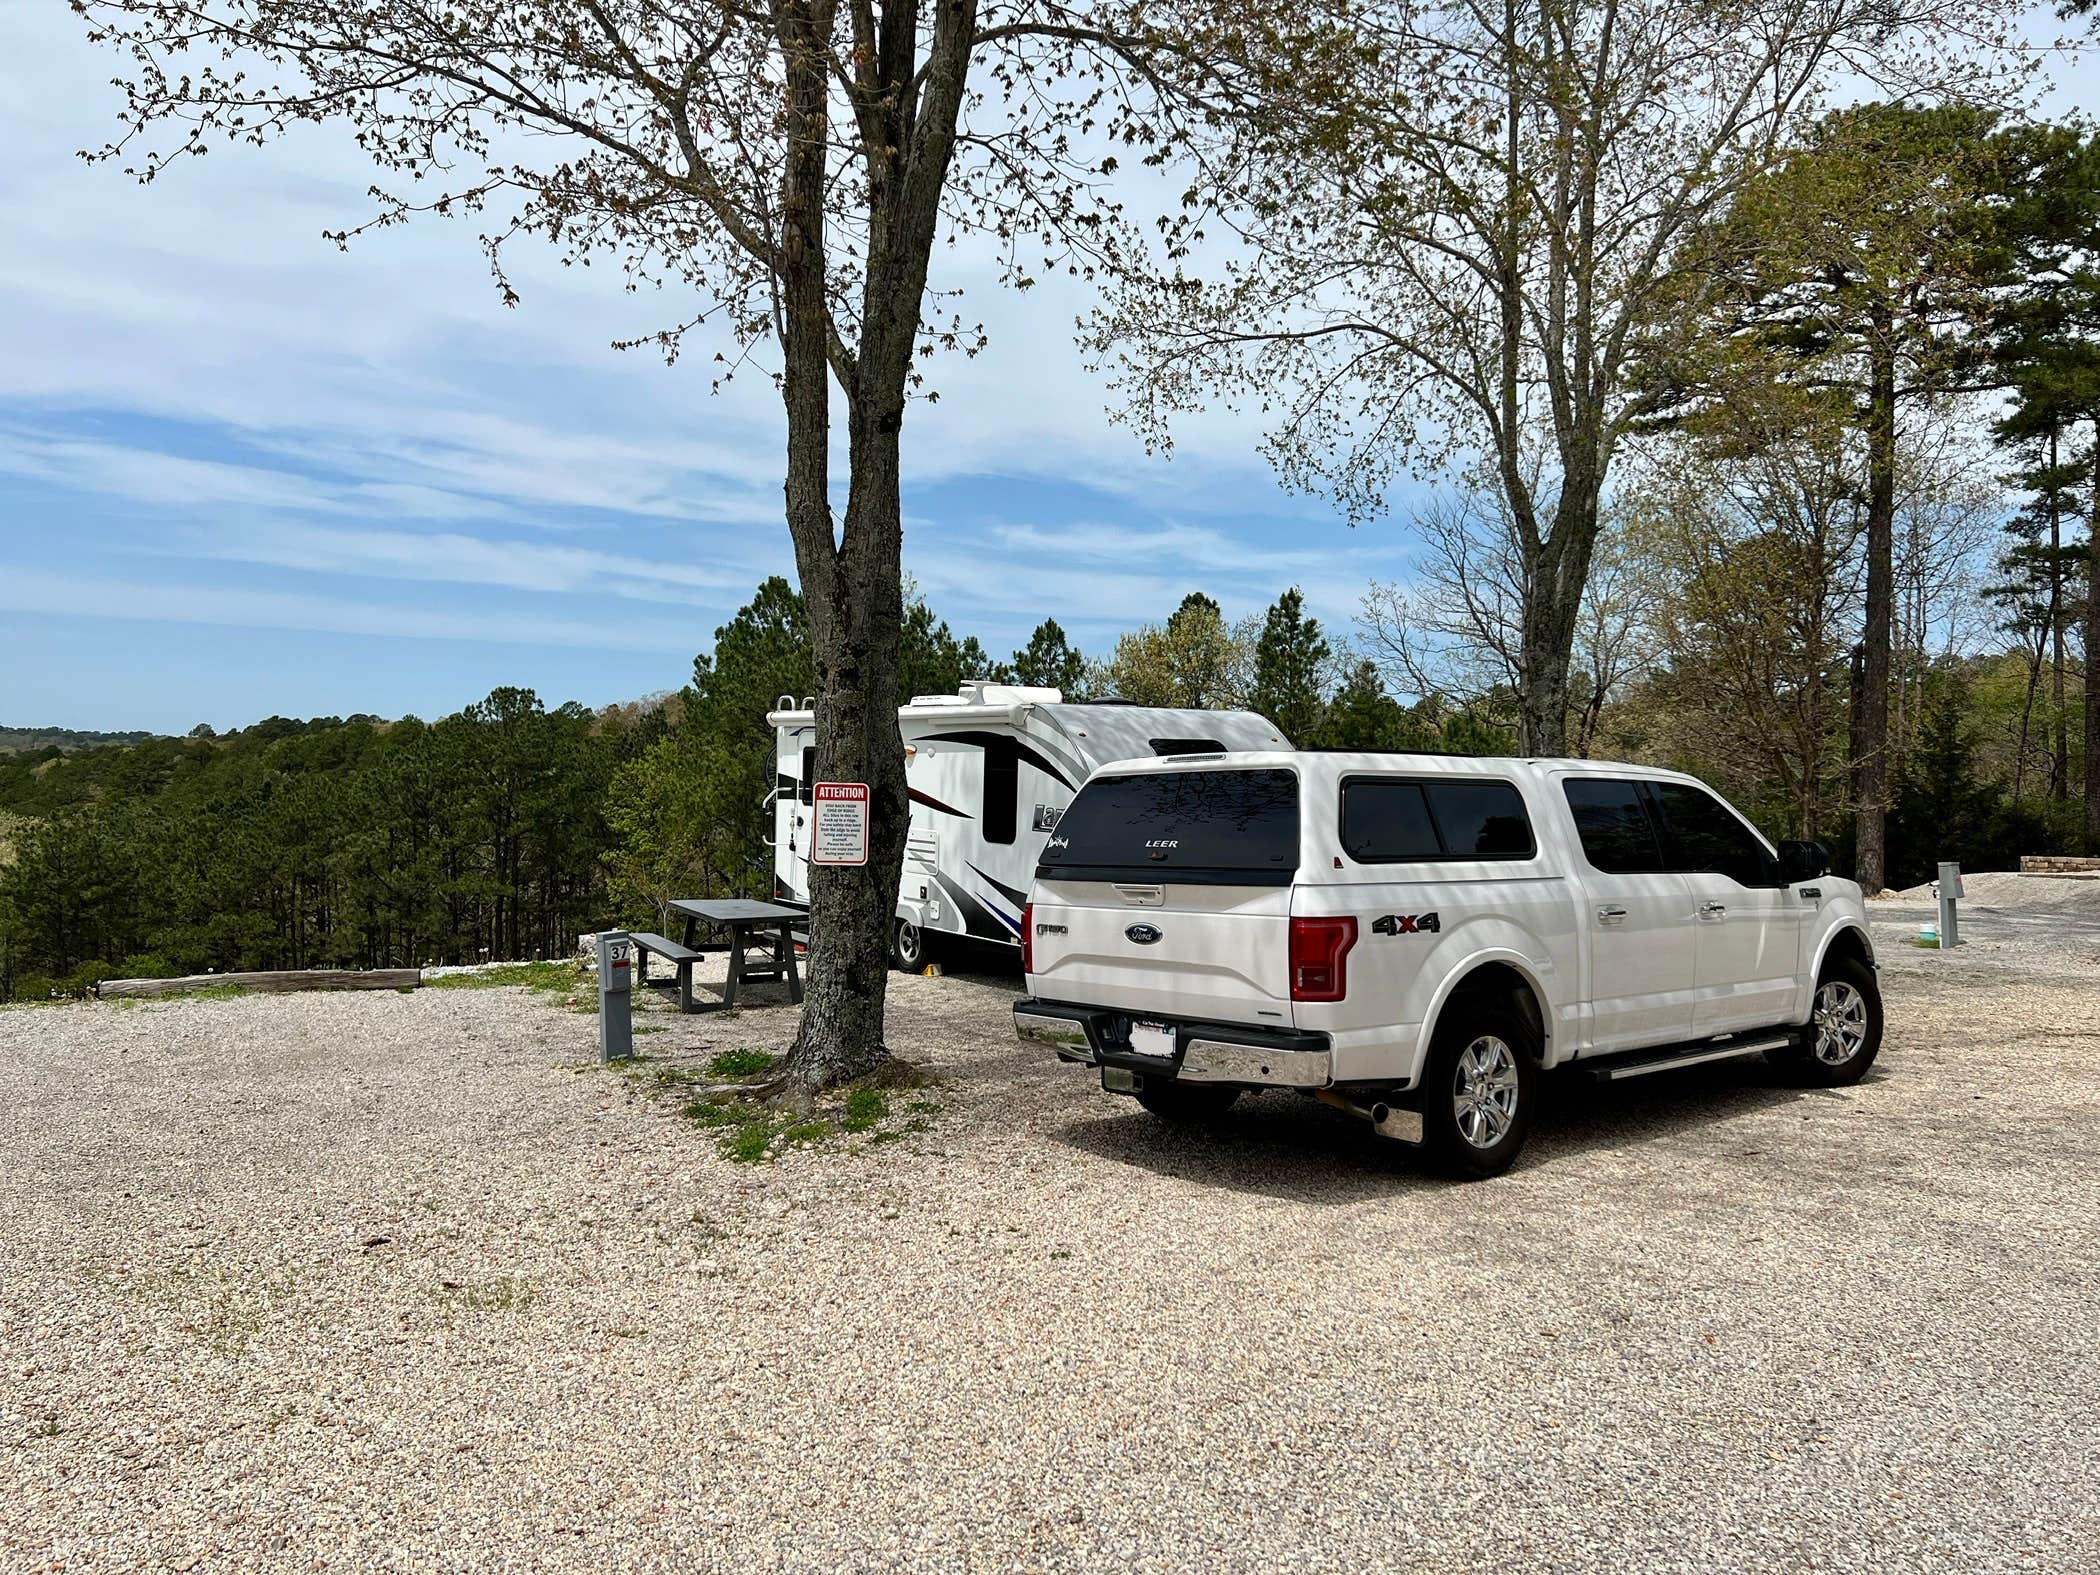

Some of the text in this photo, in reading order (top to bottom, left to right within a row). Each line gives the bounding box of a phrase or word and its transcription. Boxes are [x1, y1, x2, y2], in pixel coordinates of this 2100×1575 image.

[819, 786, 864, 798] ATTENTION
[1145, 840, 1178, 848] LEER
[612, 946, 628, 960] 37
